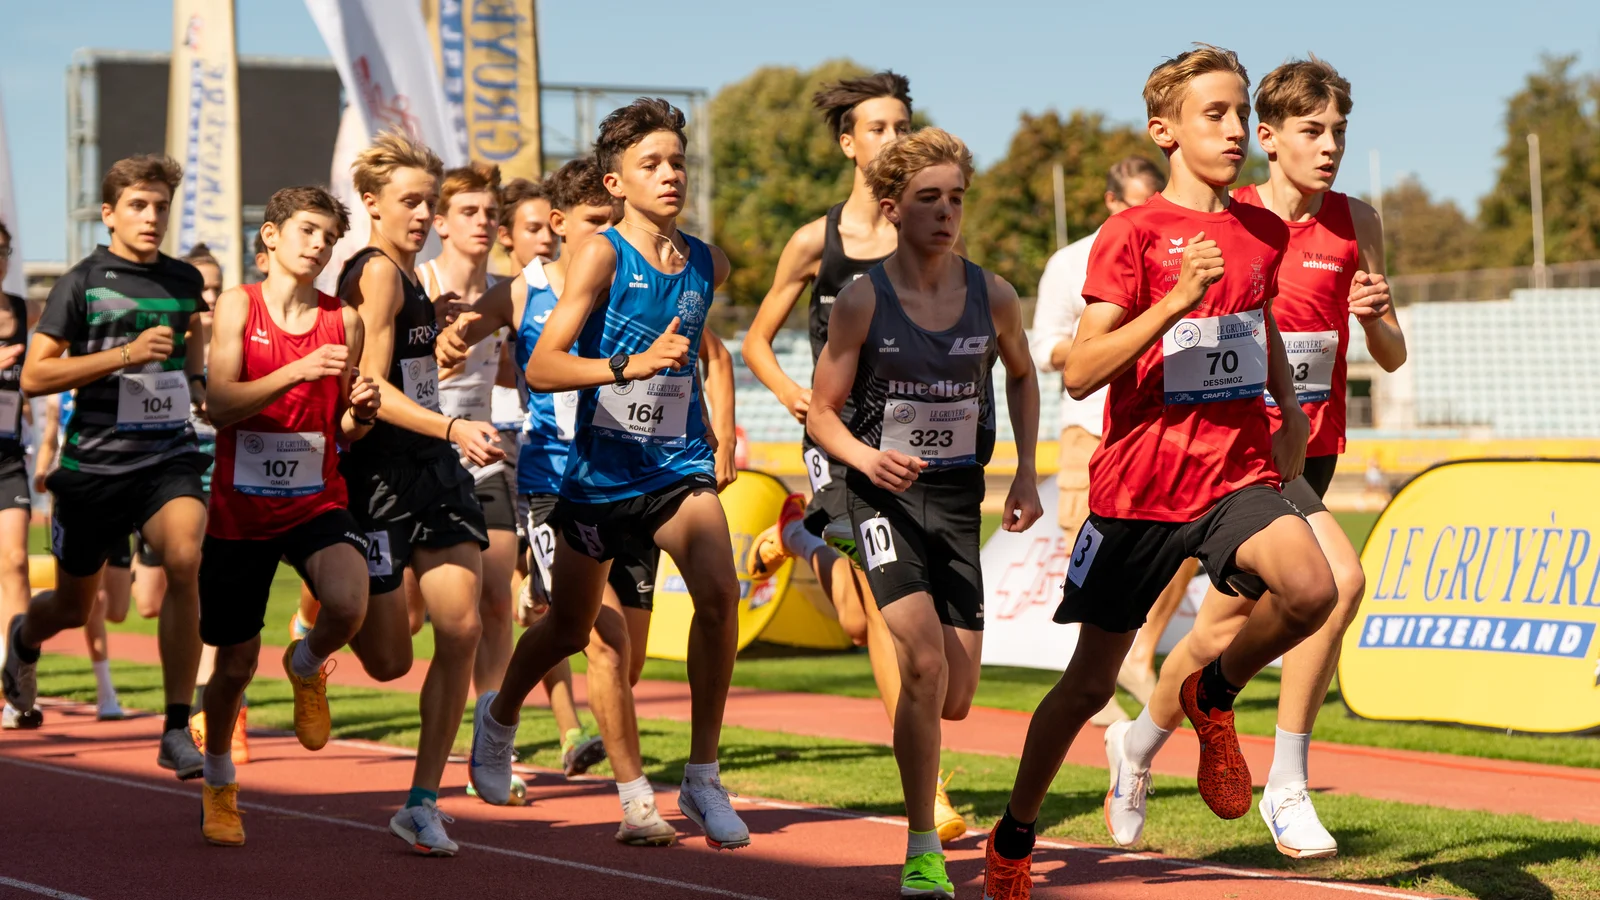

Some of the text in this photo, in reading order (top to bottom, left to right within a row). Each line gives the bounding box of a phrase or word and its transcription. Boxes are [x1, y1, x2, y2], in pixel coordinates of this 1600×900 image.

[1168, 246, 1186, 254] erim
[1302, 251, 1314, 259] TV
[1302, 261, 1344, 273] athletics
[1206, 350, 1239, 375] 70
[415, 379, 435, 400] 243
[888, 379, 976, 397] medica
[1203, 376, 1243, 387] DESSIMOZ
[141, 396, 173, 413] 104
[1202, 391, 1226, 400] CRAFT
[627, 402, 665, 425] 164
[628, 424, 657, 433] KOHLER
[908, 429, 954, 448] 323
[262, 459, 299, 478] 107
[812, 454, 822, 478] 8
[343, 531, 369, 549] JAKO
[534, 529, 554, 559] 12
[864, 524, 891, 557] 10
[368, 538, 383, 566] 4
[1073, 533, 1093, 568] 3
[1372, 527, 1424, 601] LE
[1365, 616, 1583, 655] SWITZERLAND
